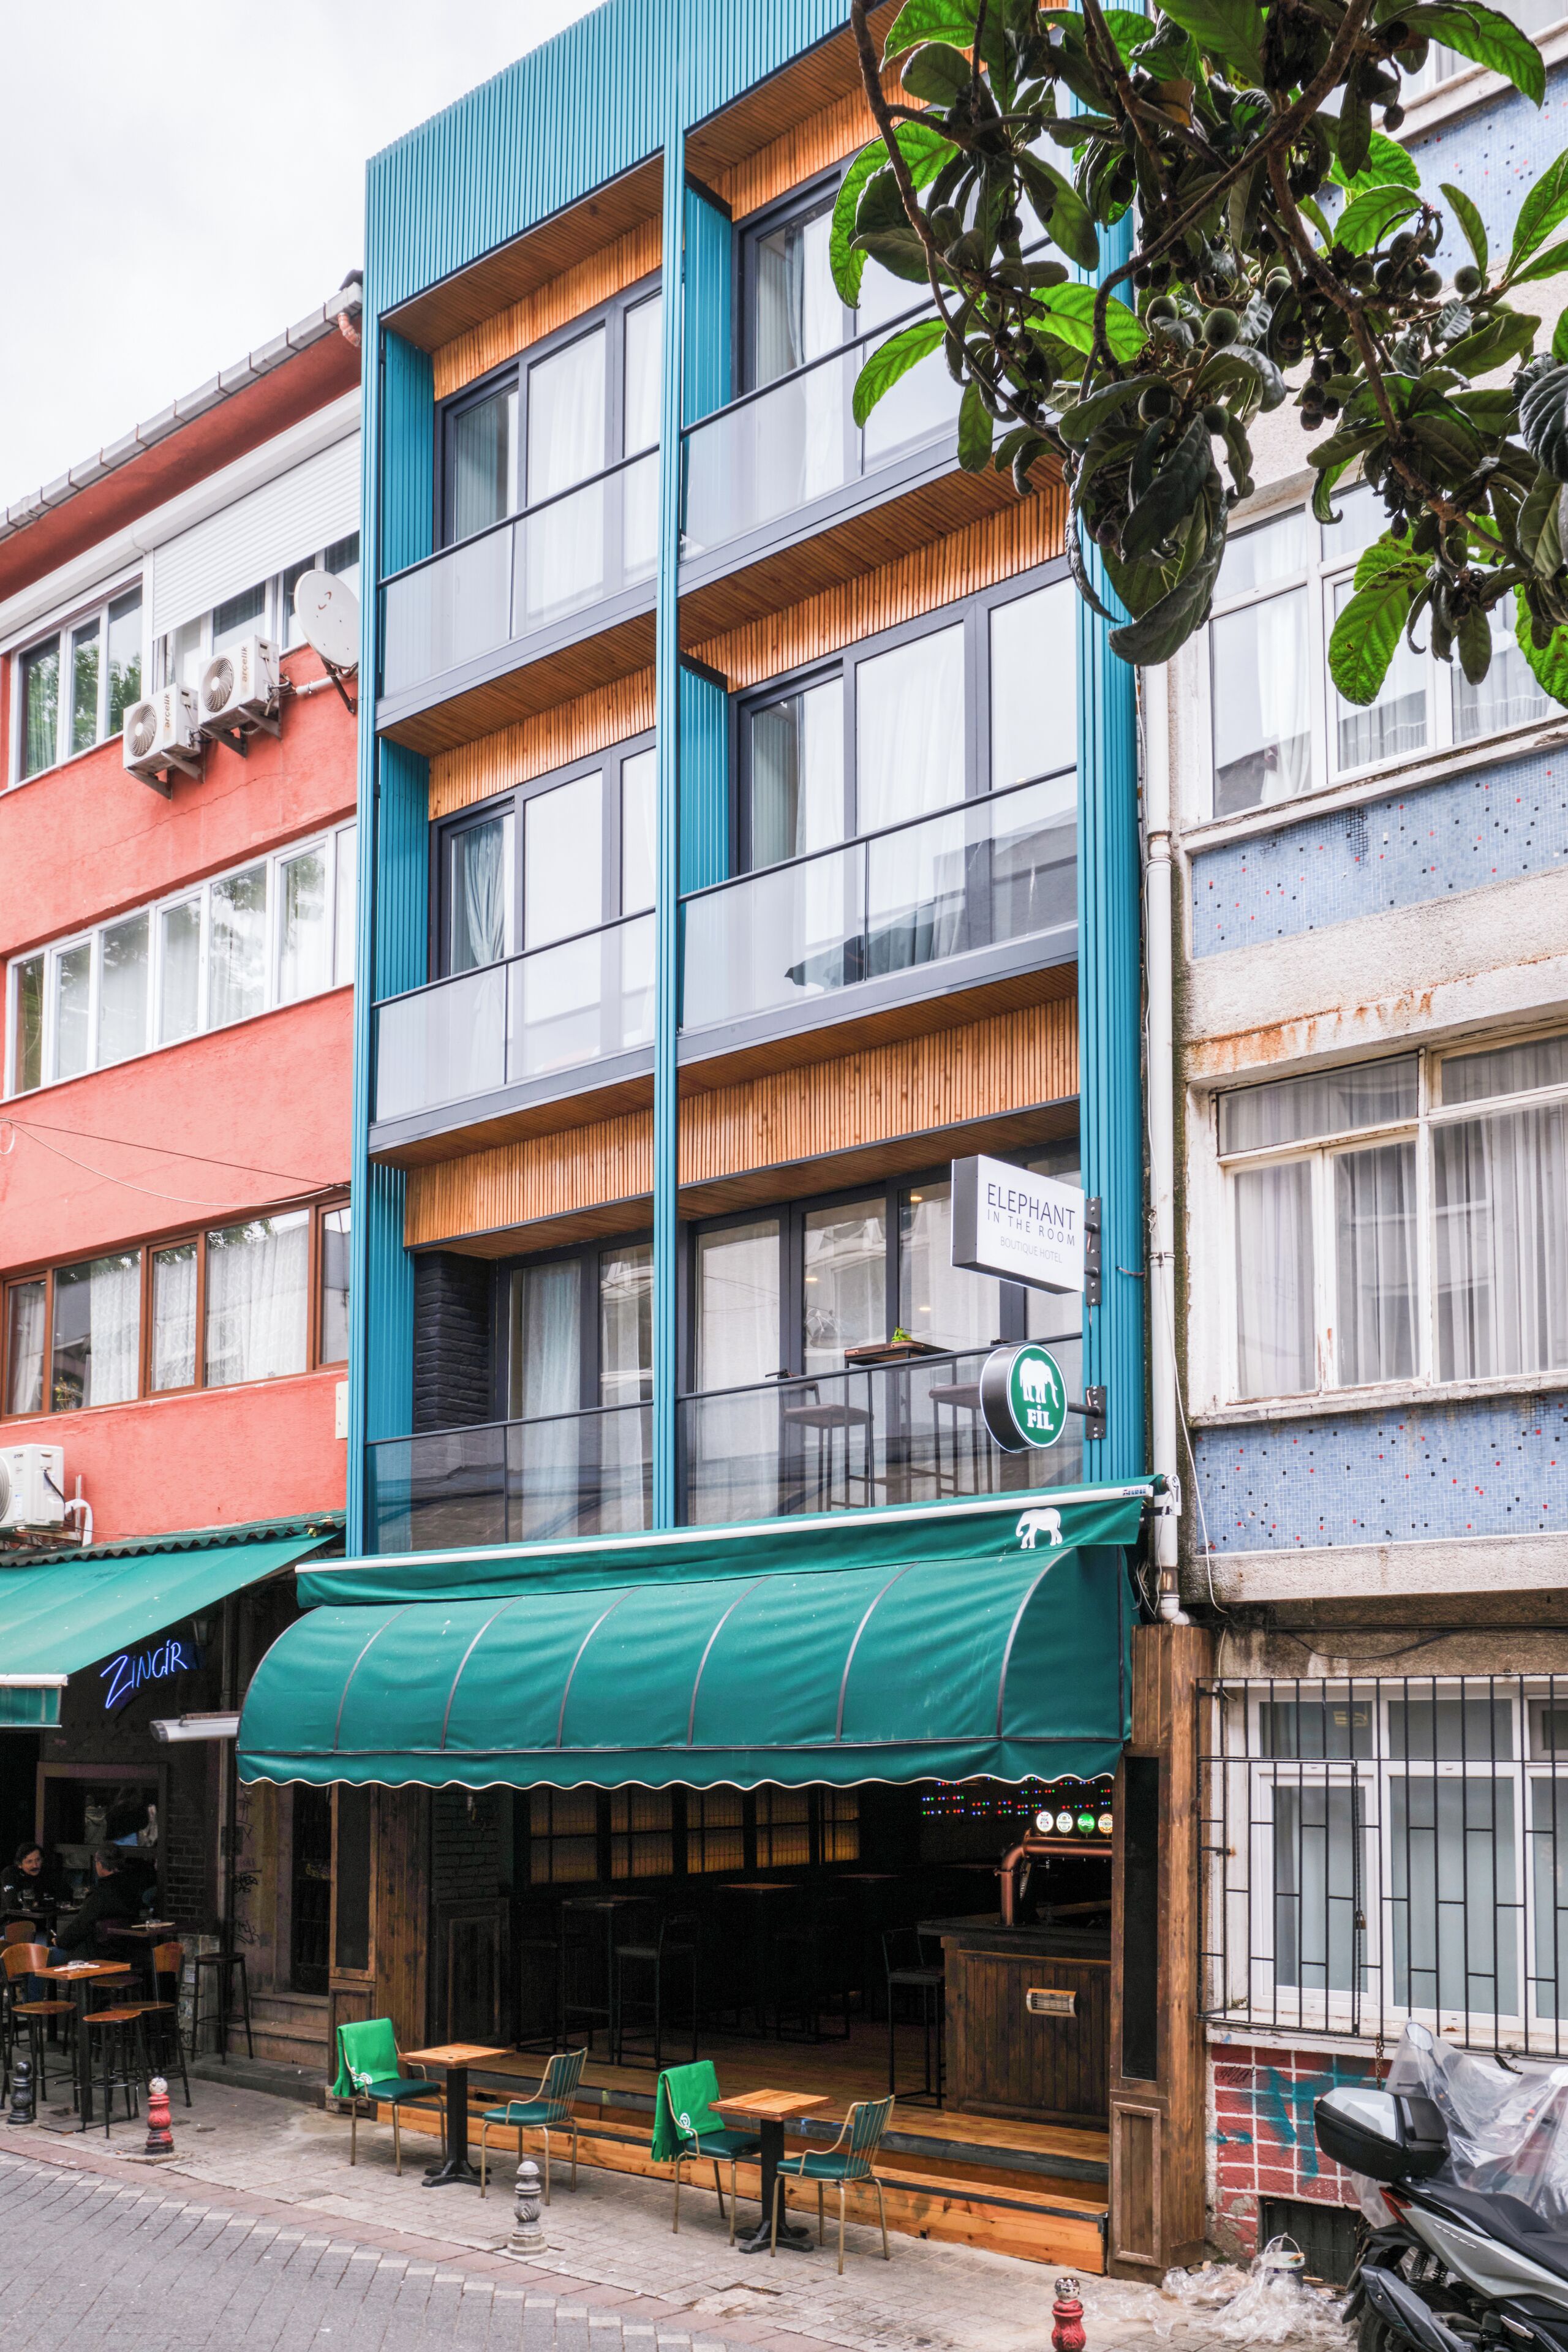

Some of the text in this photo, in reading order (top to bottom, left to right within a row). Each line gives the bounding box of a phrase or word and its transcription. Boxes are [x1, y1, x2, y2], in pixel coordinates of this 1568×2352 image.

[988, 1183, 1075, 1230] ELEPHANT
[987, 1209, 1075, 1246] IN THE ROOM
[1000, 1235, 1062, 1263] BOUTIQUE HOTEL
